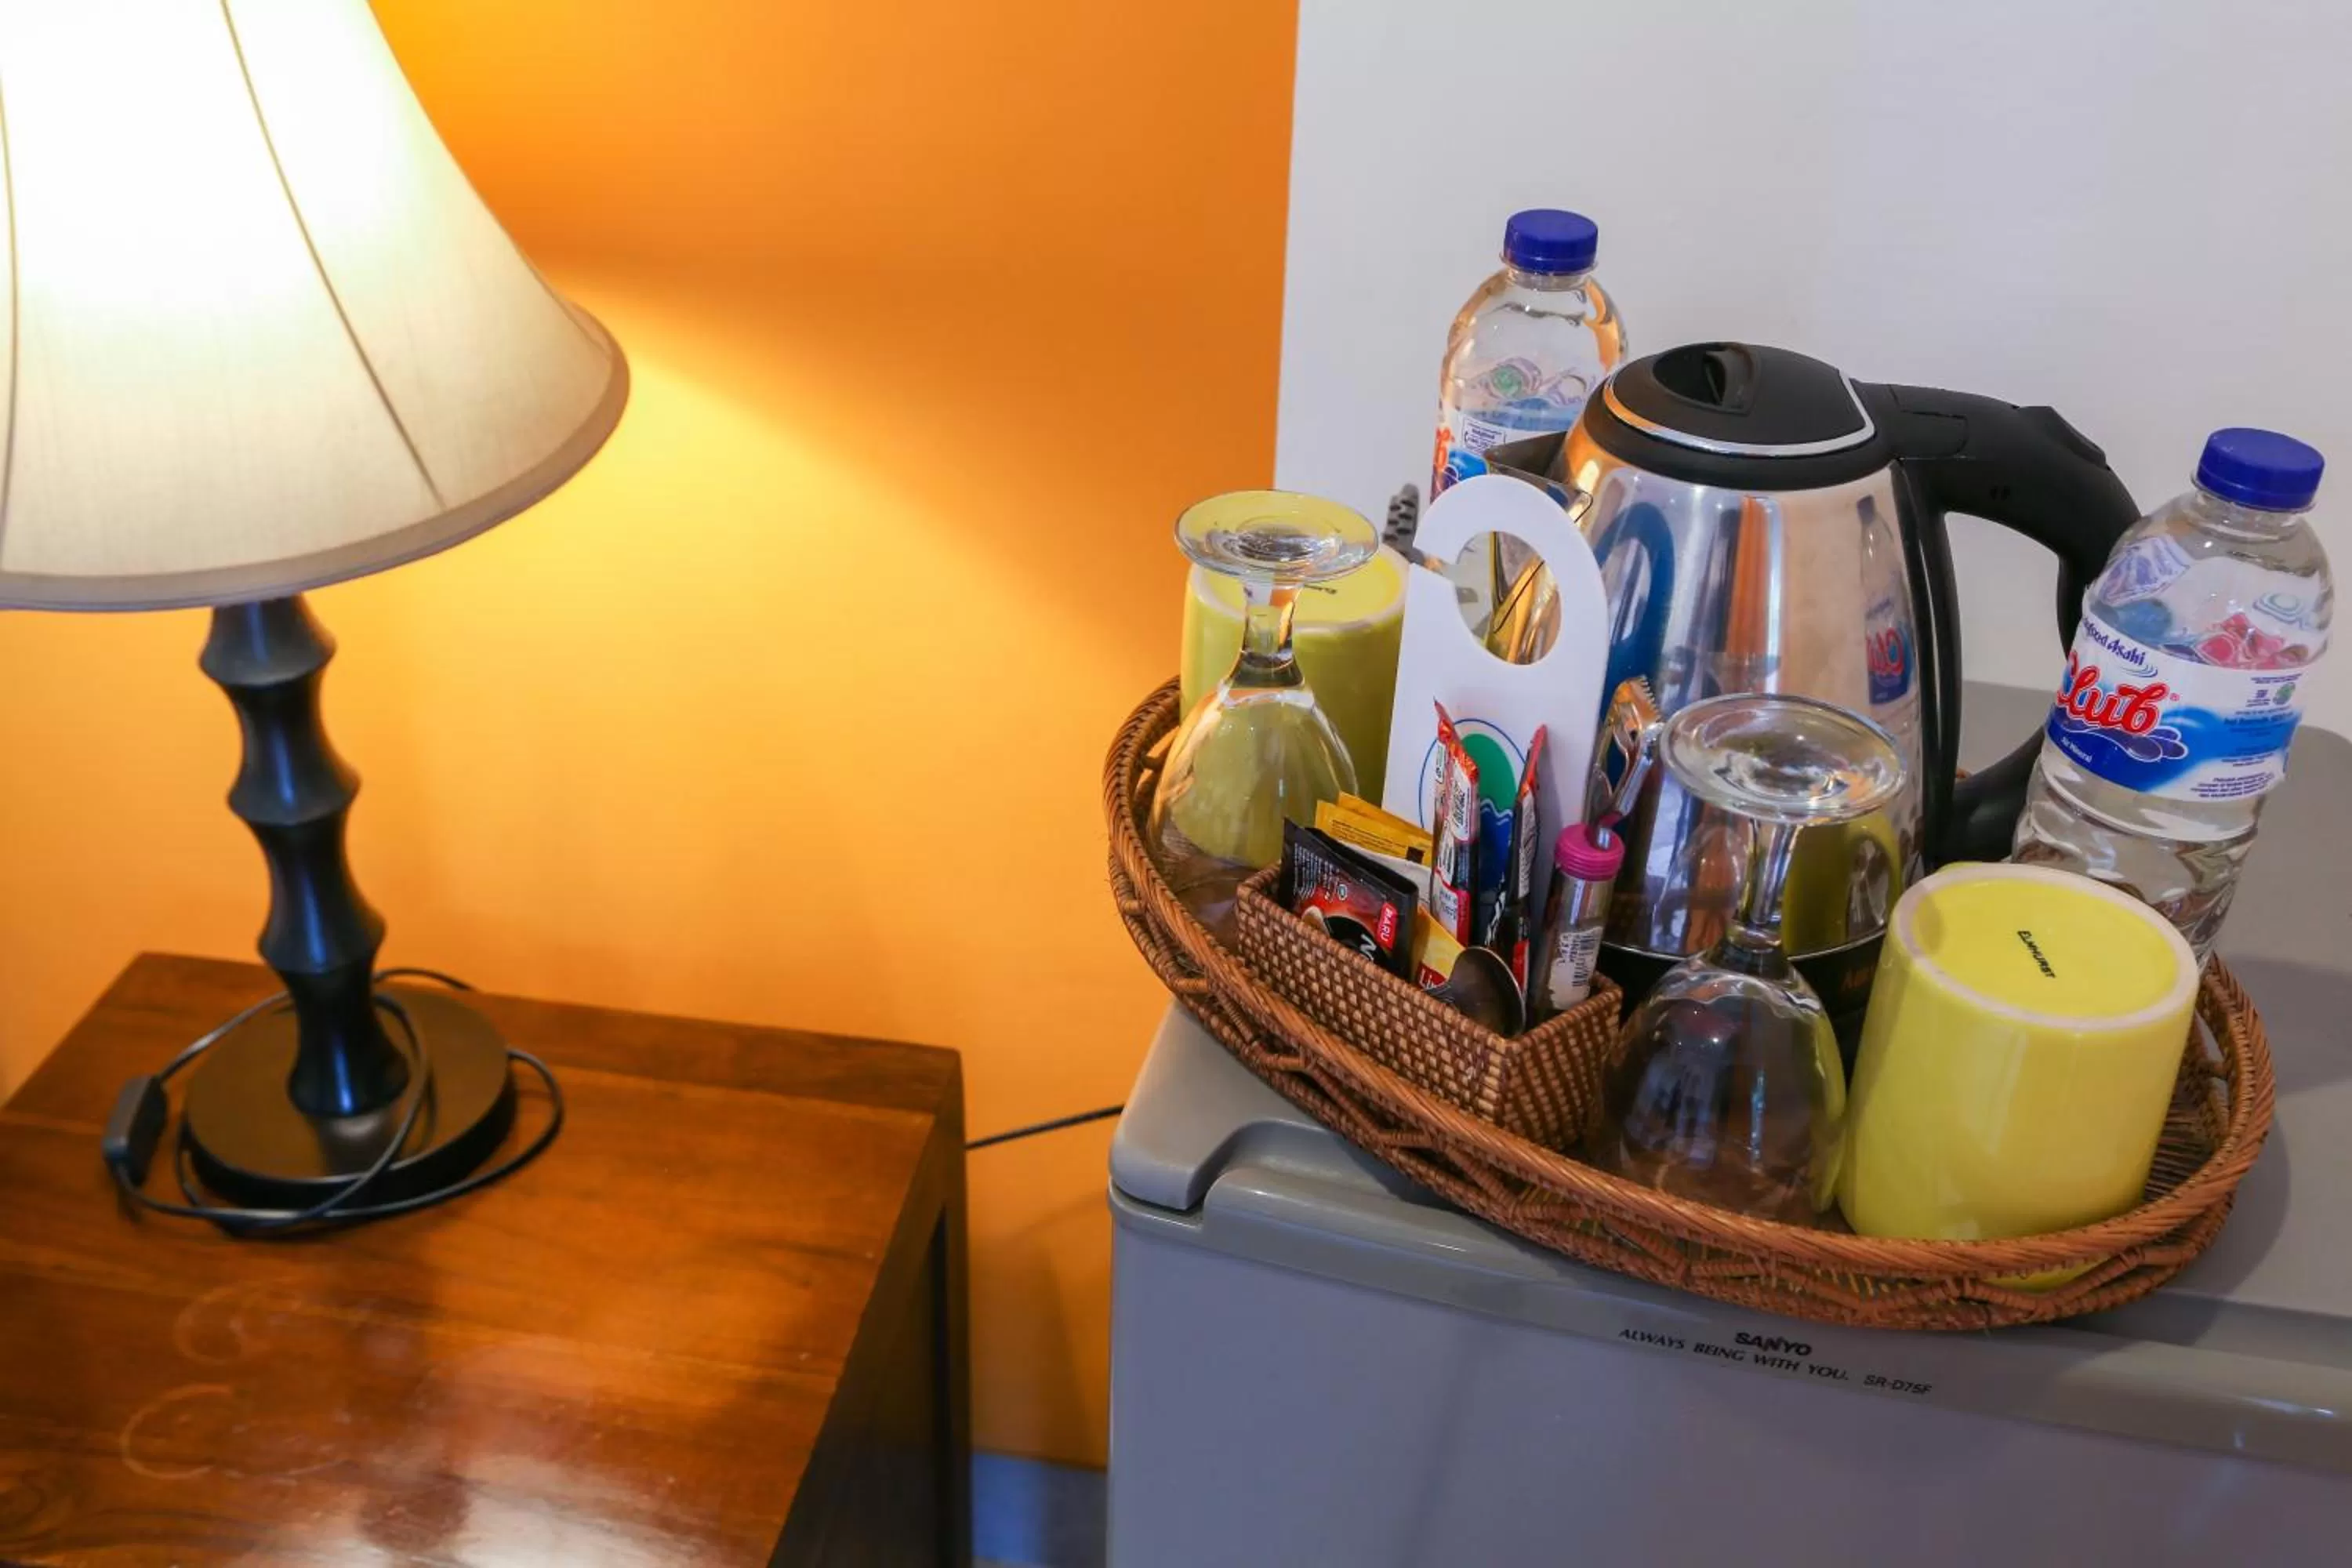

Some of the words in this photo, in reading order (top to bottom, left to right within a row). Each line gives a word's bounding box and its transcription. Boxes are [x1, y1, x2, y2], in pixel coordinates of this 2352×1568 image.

[2107, 639, 2146, 666] Asahi
[1618, 1329, 1686, 1349] ALWAYS
[1693, 1341, 1746, 1362] BEING
[1754, 1354, 1801, 1372] WITH
[1808, 1363, 1849, 1381] YOU.
[1735, 1332, 1813, 1356] SANYO
